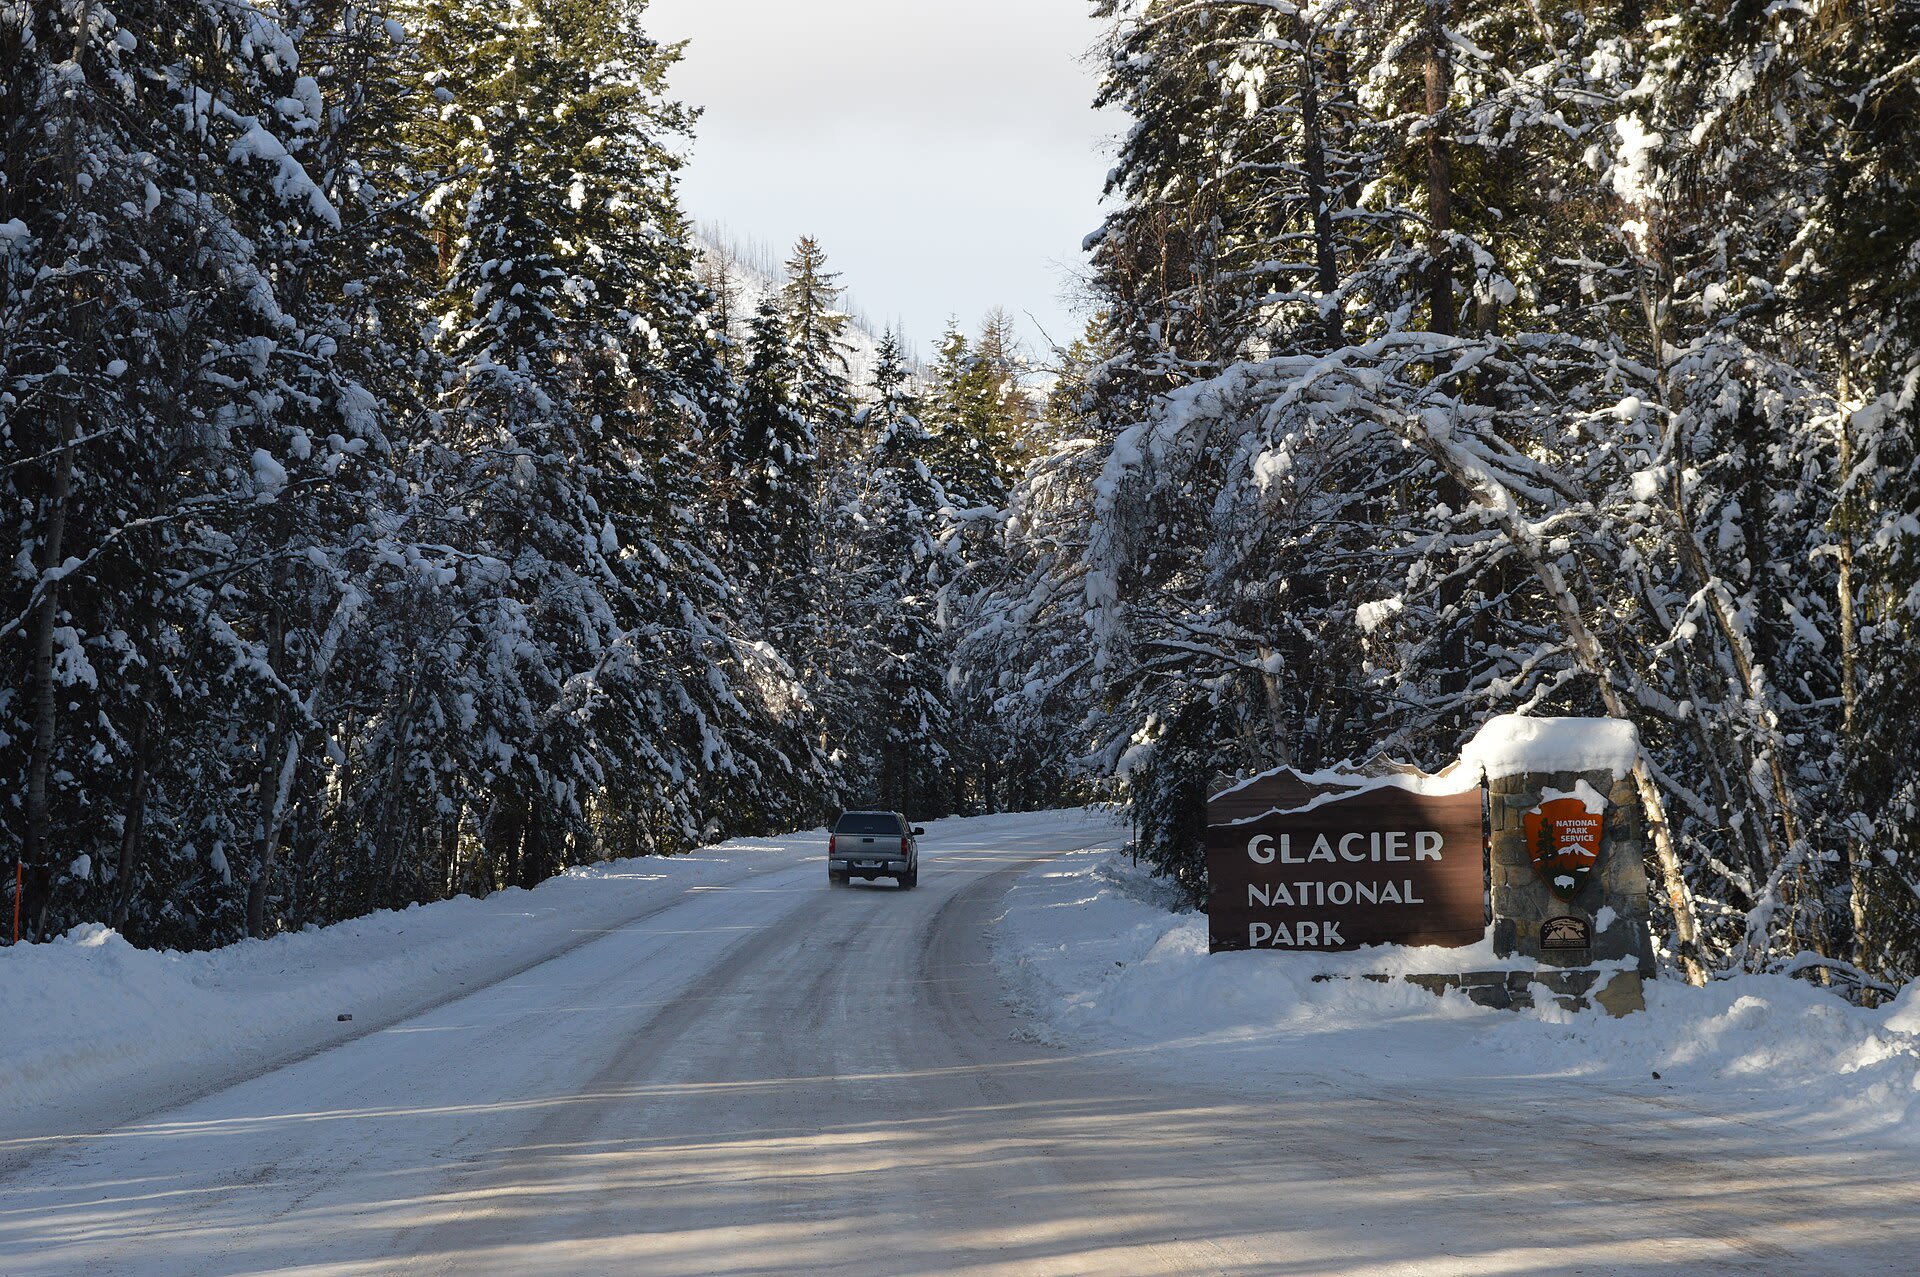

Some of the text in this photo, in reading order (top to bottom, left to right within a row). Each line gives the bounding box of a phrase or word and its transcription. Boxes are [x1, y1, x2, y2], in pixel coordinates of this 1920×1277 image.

[1556, 819, 1598, 827] NATIONAL
[1247, 831, 1444, 864] GLACIER
[1561, 834, 1594, 842] SERVICE
[1248, 880, 1424, 907] NATIONAL
[1249, 921, 1346, 947] PARK
